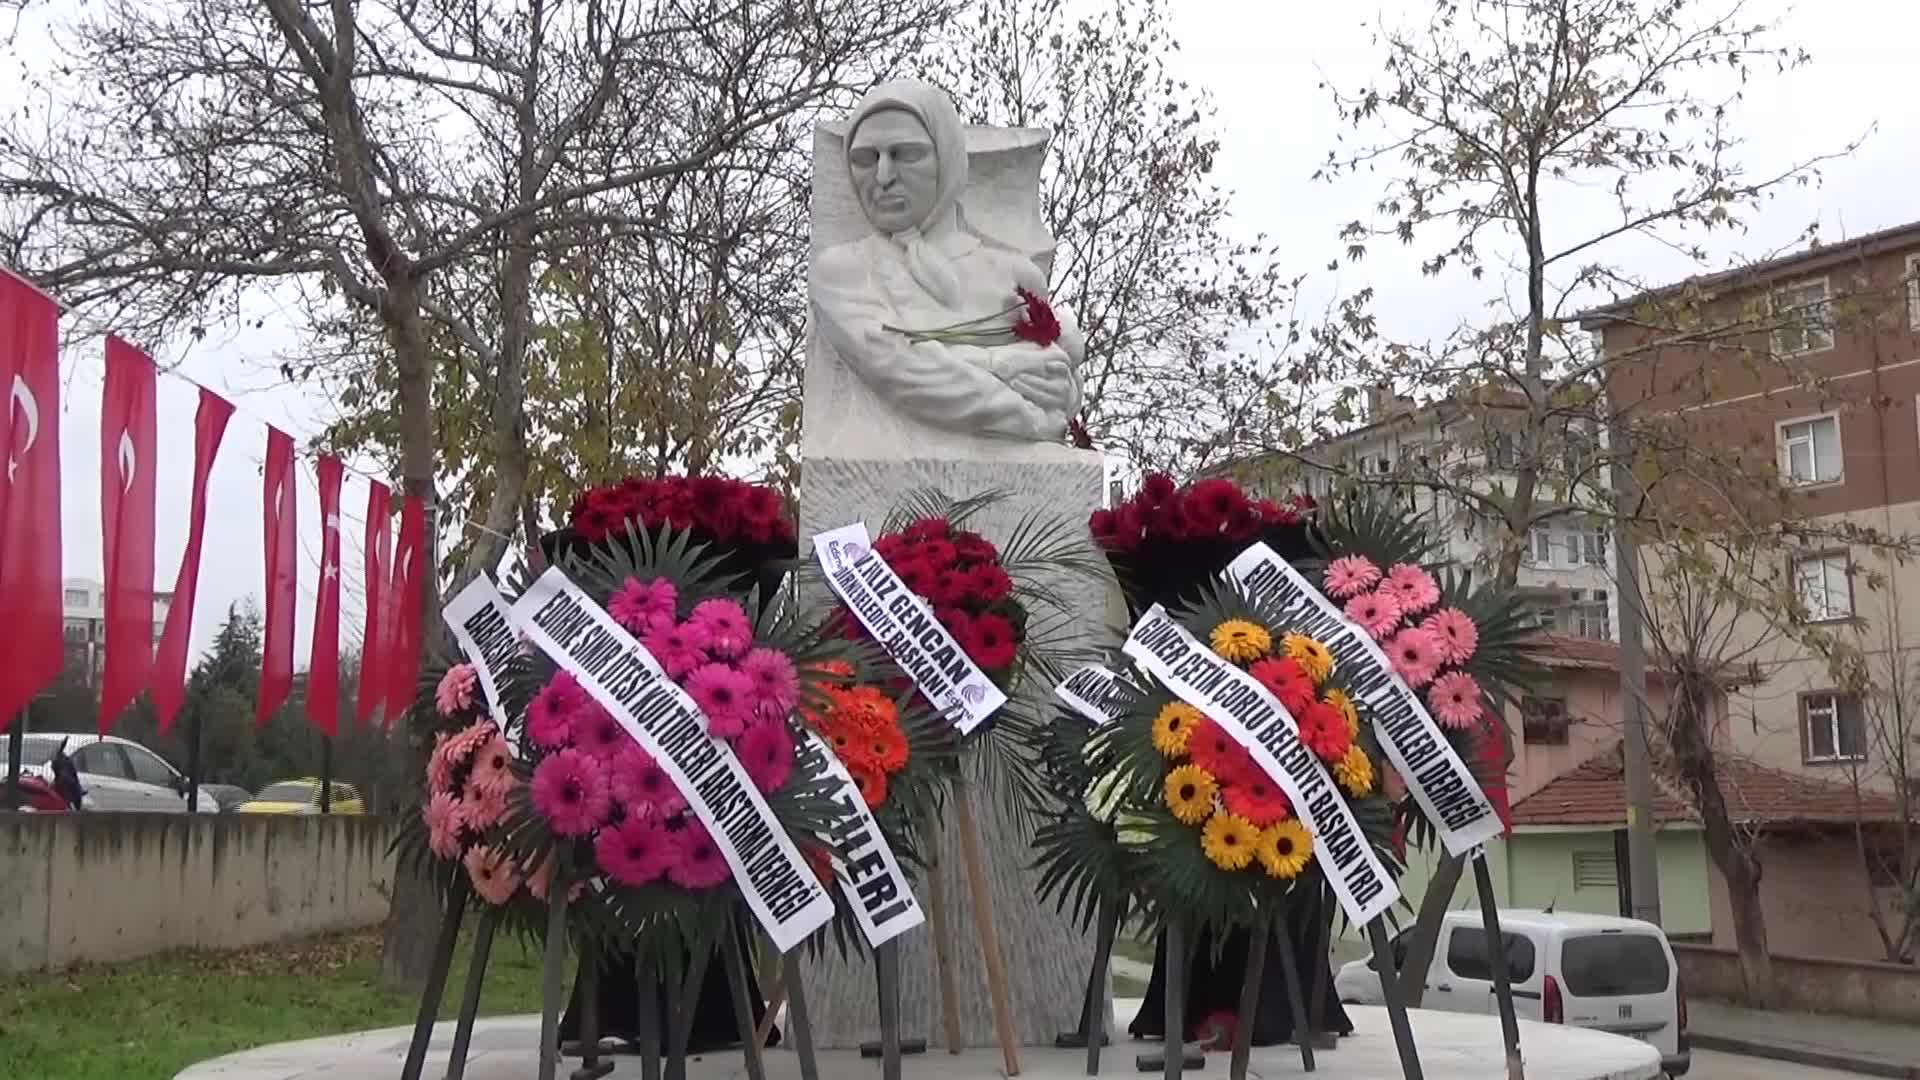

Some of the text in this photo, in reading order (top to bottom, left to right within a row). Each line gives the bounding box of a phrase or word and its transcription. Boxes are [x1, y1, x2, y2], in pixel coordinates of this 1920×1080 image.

[532, 589, 595, 650] EDİRNE
[568, 624, 623, 678] SINIR
[852, 587, 896, 639] BELEDİYE
[885, 630, 949, 698] BAŞKANI
[888, 595, 972, 685] GENCAN
[597, 645, 661, 706] ÖTESİ
[1242, 558, 1304, 614] EDİRNE
[1330, 632, 1391, 698] BALKAN
[1375, 685, 1447, 772] TÜRKLERİ
[1416, 758, 1491, 832] DERNEĞİ
[627, 684, 728, 785] KÜLTÜRLERİ
[1133, 616, 1383, 912] GÜNER ÇETİN ÇORLU BELEDİYE BAŞKAN YRD.
[695, 763, 774, 867] ARAŞTIRMA
[747, 843, 822, 925] DERNEĞİ
